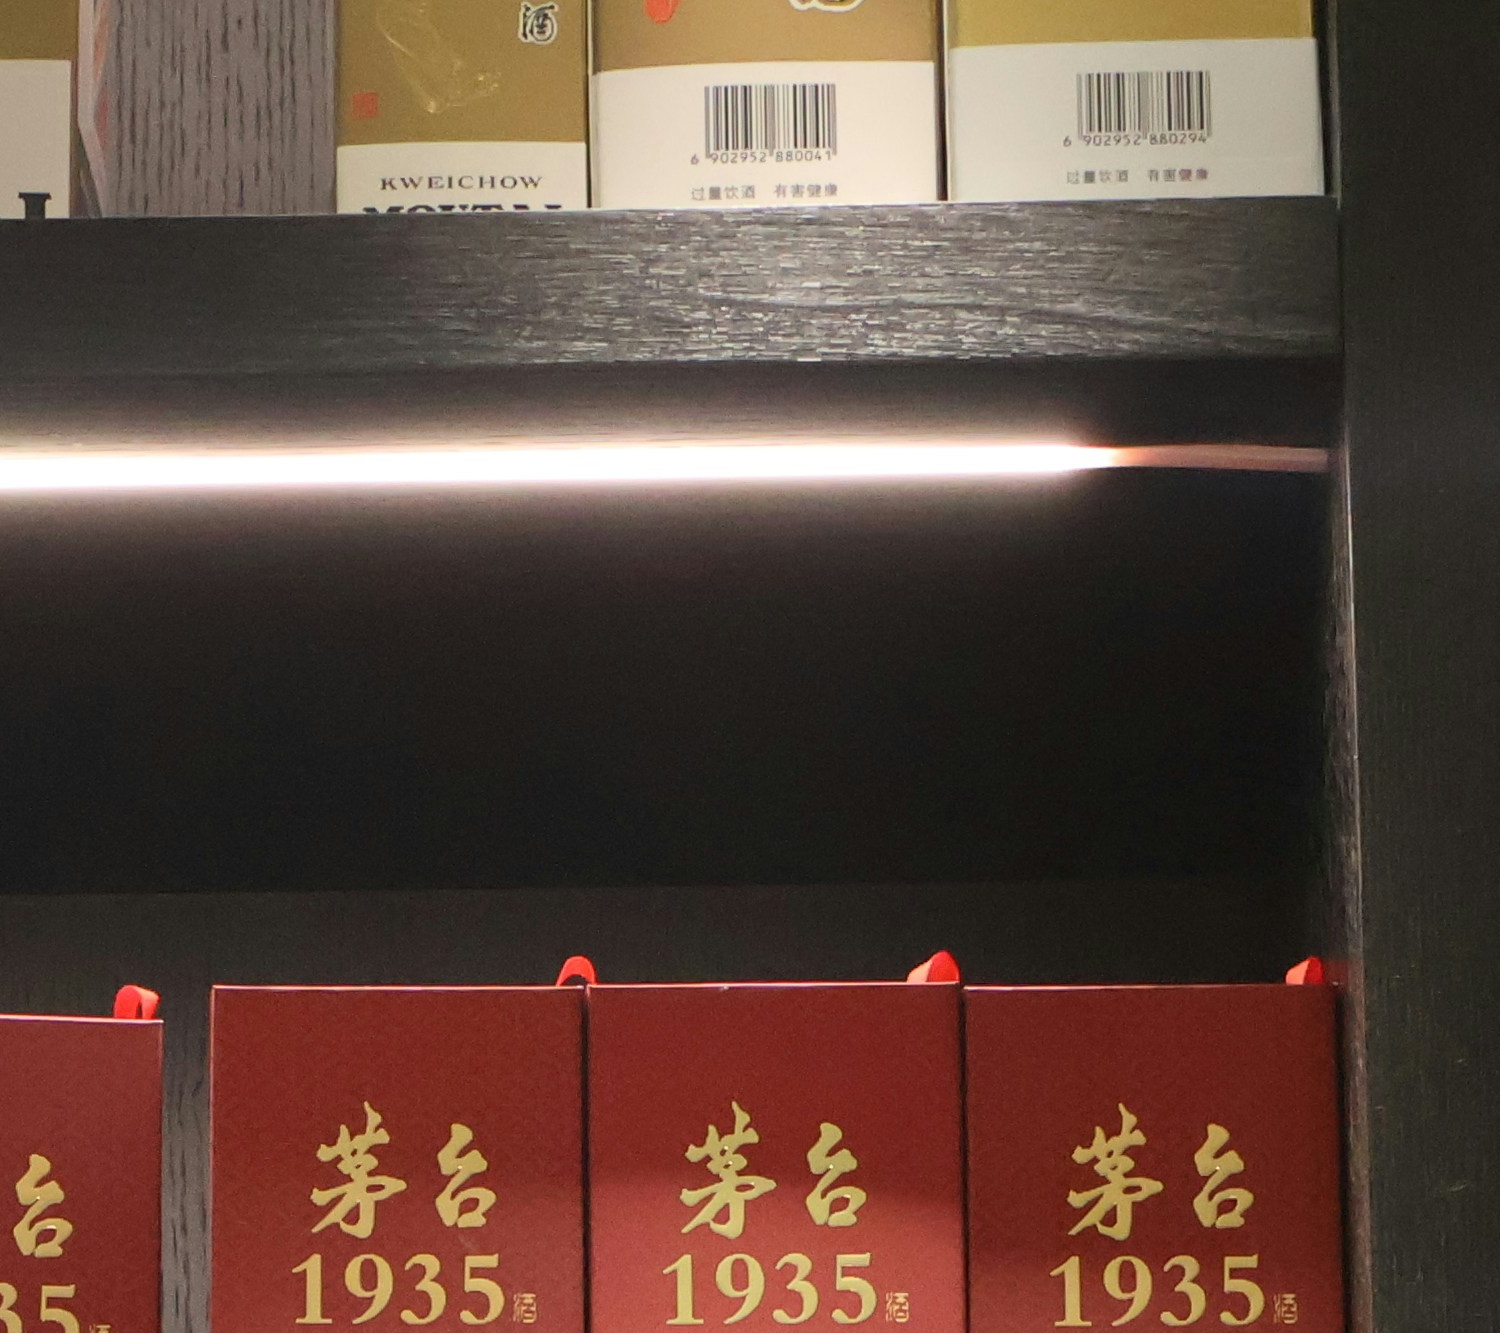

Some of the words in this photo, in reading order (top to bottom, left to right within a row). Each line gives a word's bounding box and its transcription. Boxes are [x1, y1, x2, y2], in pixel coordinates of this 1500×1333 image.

[690, 154, 699, 165] 6
[711, 153, 767, 164] 902952
[775, 150, 833, 162] 880041
[1063, 137, 1072, 147] 6
[1083, 134, 1141, 146] 902952
[1150, 133, 1206, 145] 880294
[381, 176, 542, 190] KWEICHOW
[692, 185, 755, 200] 过量饮酒
[774, 184, 837, 198] 有害健康
[310, 1101, 498, 1239] 茅台
[680, 1101, 867, 1239] 茅台
[1067, 1102, 1255, 1241] 茅台
[292, 1254, 505, 1325] 1935
[662, 1253, 878, 1325] 1935
[1049, 1254, 1265, 1327] 1935
